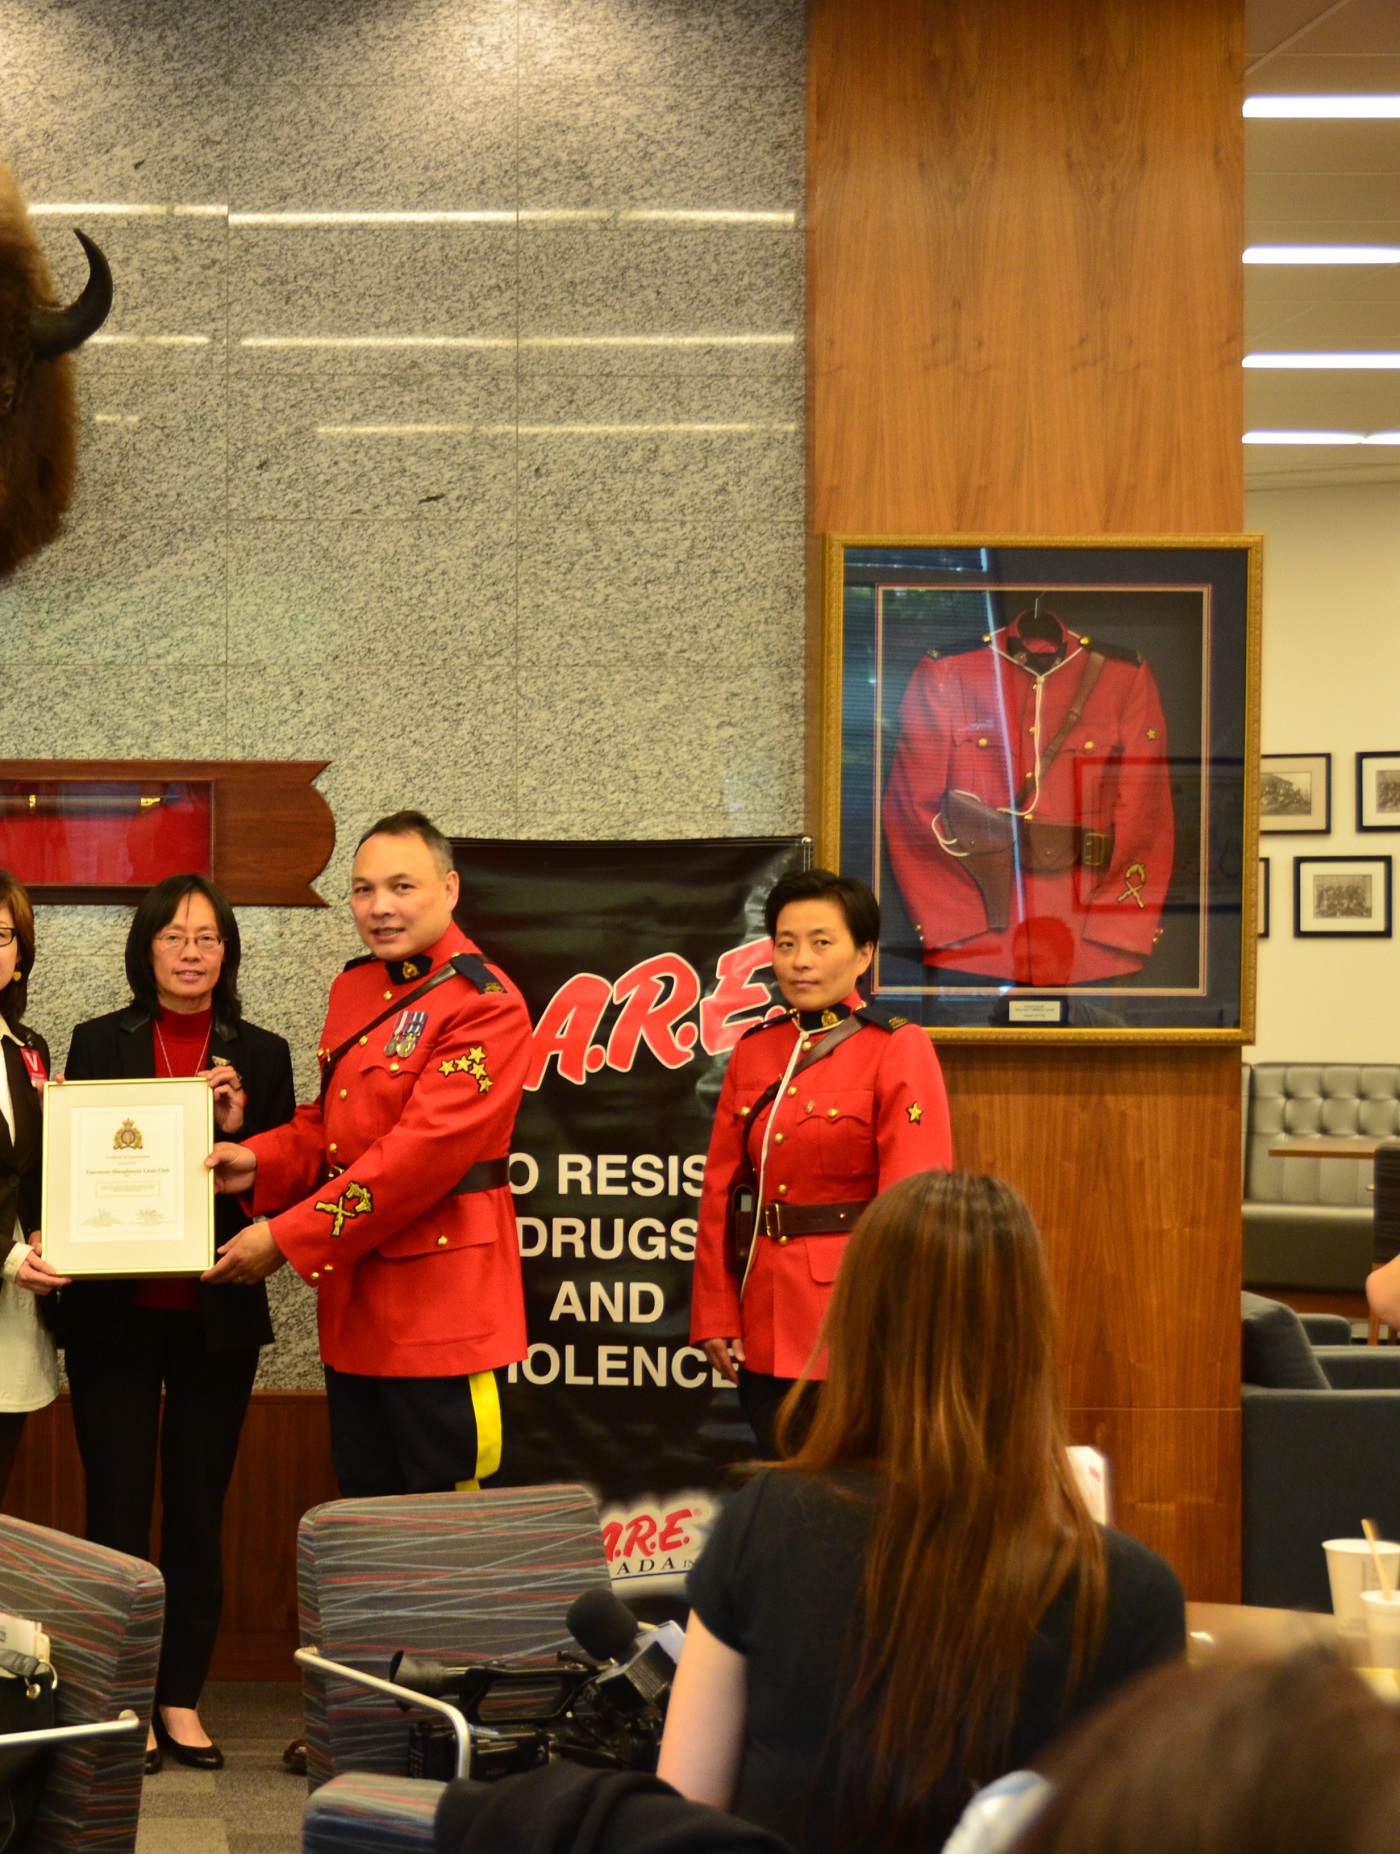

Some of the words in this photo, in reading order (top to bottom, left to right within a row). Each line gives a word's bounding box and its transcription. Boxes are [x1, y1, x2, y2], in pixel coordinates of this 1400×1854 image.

[25, 1052, 38, 1071] V
[557, 1153, 708, 1197] RESIS
[515, 1216, 699, 1262] DRUGS
[549, 1280, 664, 1323] AND
